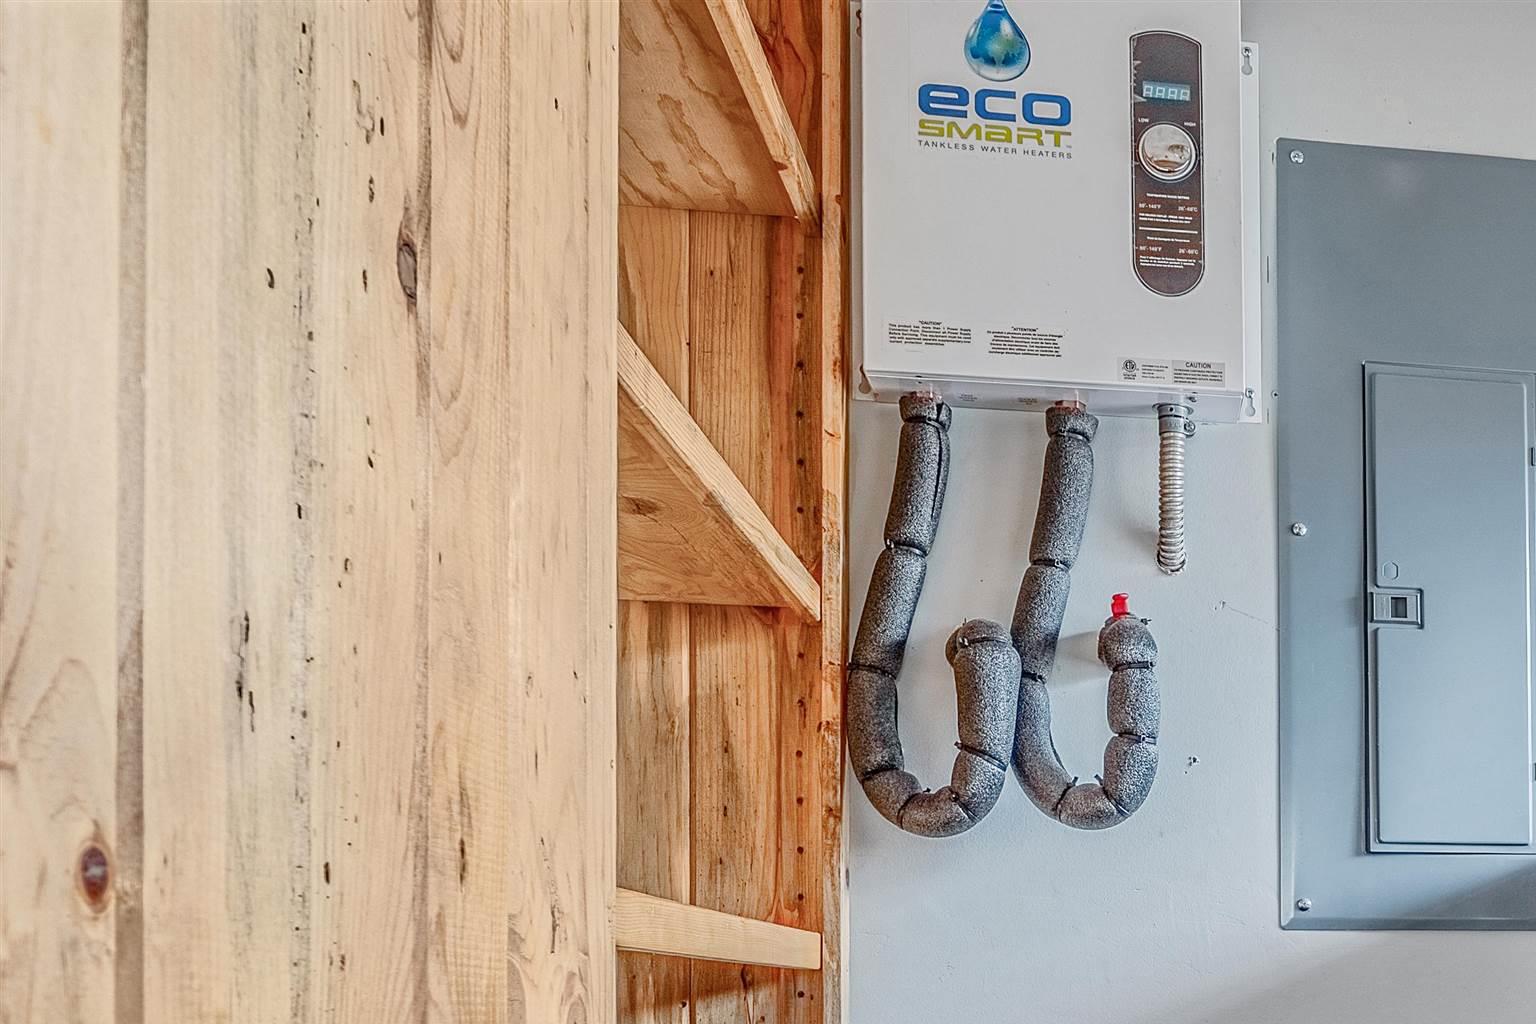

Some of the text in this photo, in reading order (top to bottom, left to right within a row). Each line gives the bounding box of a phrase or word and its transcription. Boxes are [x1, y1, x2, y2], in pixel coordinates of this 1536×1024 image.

[918, 83, 1072, 127] eco
[918, 139, 1073, 159] TANKLESS WATER HEATERS
